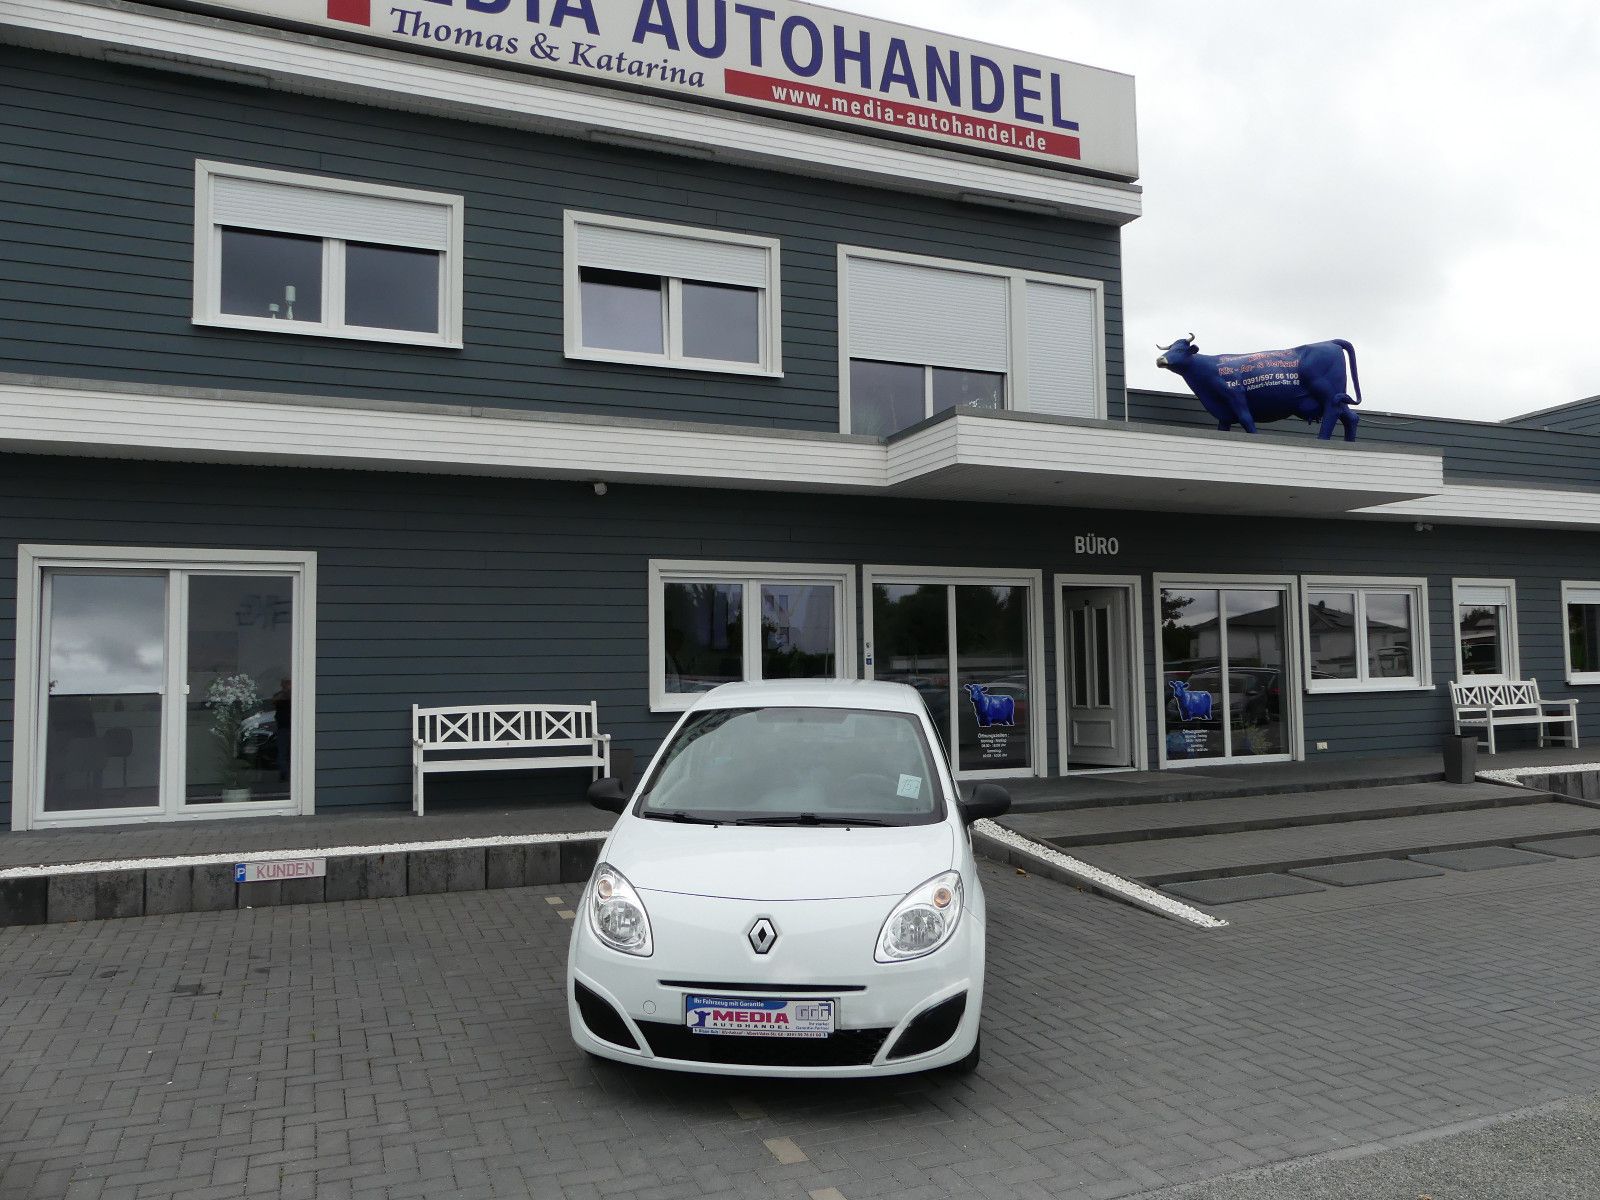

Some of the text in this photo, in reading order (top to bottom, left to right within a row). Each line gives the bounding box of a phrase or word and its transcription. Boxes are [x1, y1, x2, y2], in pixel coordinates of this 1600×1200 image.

[390, 7, 519, 55] Thomas
[528, 32, 561, 62] &
[569, 41, 705, 88] Katarina
[632, 0, 1080, 132] AUTOHANDEL
[771, 85, 1047, 151] www.media-autohandel.de
[1226, 380, 1240, 388] Tel.
[1242, 373, 1274, 386] 0391/597
[1074, 533, 1119, 555] BÜRO
[237, 862, 315, 879] P KUNDEN
[702, 998, 729, 1007] Fahrzeug
[712, 1009, 790, 1024] MEDIA
[713, 1022, 790, 1030] AUTOHANDEL
